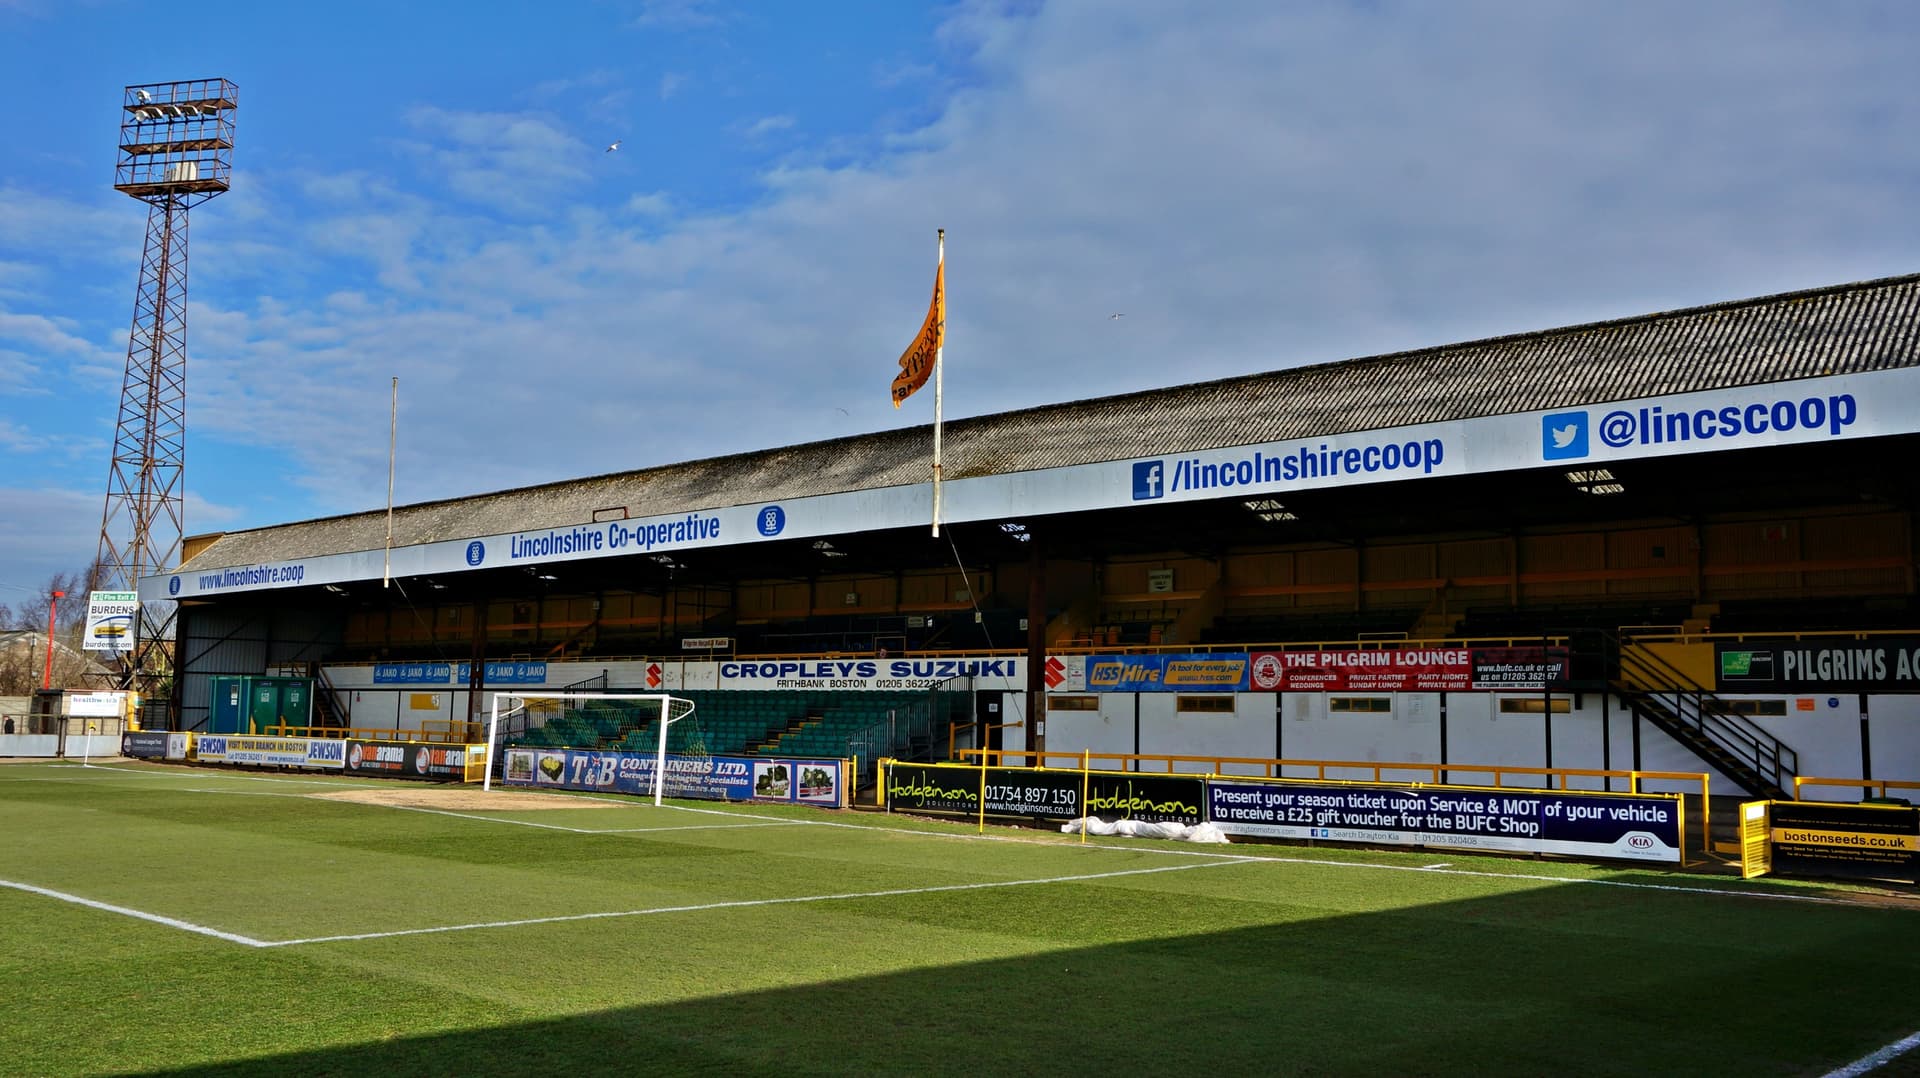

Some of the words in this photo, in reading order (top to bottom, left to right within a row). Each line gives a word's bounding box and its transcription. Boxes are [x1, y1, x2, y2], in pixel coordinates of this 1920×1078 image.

[1599, 394, 1857, 448] @lincscoop
[1171, 438, 1444, 492] /lincolnshirecoop
[511, 526, 603, 559] Lincolnshire
[608, 514, 720, 550] Co-operative
[199, 564, 304, 590] www.lincolnshire.coop
[91, 605, 134, 614] BURDENS
[1285, 654, 1316, 667] THE
[1321, 652, 1390, 666] PILGRIM
[1396, 650, 1469, 665] LOUNGE
[1783, 648, 1887, 681] PILGRIMS
[382, 667, 398, 677] JAKO
[407, 667, 423, 677] JAKO
[433, 667, 449, 677] JAKO
[495, 667, 514, 677] JAKO
[526, 666, 545, 677] JAKO
[721, 662, 877, 679] CROPLEYS
[890, 660, 1015, 678] SUZUKI
[1094, 667, 1119, 681] HSS
[1122, 665, 1160, 682] Hire
[1194, 664, 1205, 672] for
[1205, 664, 1226, 673] every
[1477, 664, 1534, 672] www.bufc.co.uk
[777, 679, 825, 688] FRITHBANK
[829, 680, 867, 688] BOSTON
[876, 679, 902, 688] 01205
[1502, 673, 1526, 681] 01205
[199, 738, 226, 753] JEWSON
[285, 742, 307, 751] BOSTON
[309, 741, 342, 760] JEWSON
[362, 745, 404, 762] vanarama
[571, 756, 618, 786] T&B
[715, 762, 749, 775] LTD.
[704, 776, 749, 785] Specialists
[887, 770, 977, 807] Hodgkinsons
[985, 785, 1022, 800] 01754
[1025, 787, 1047, 802] 897
[1052, 789, 1076, 805] 150
[926, 800, 978, 809] SOLICITORS
[985, 801, 1076, 815] www.hodgkinsons.co.uk
[1214, 789, 1262, 804] Present
[1265, 792, 1294, 807] your
[1298, 793, 1345, 808] season
[1348, 794, 1386, 809] ticket
[1391, 798, 1426, 812] upon
[1430, 797, 1484, 813] Service
[1488, 799, 1500, 814] &
[1503, 799, 1540, 816] MOT
[1545, 800, 1562, 817] of
[1567, 803, 1605, 821] your
[1609, 805, 1668, 823] vehicle
[1134, 813, 1198, 823] SOLICITORS
[1215, 805, 1228, 819] to
[1231, 808, 1274, 821] receive
[1277, 810, 1285, 821] a
[1287, 808, 1313, 823] £25
[1317, 809, 1341, 826] gift
[1344, 811, 1398, 826] voucher
[1401, 813, 1422, 828] for
[1426, 813, 1451, 829] the
[1455, 815, 1496, 831] BUFC
[1500, 818, 1539, 837] Shop
[1358, 832, 1386, 841] Drayton
[1388, 833, 1399, 841] Kia
[1422, 835, 1446, 843] 01205
[1632, 838, 1649, 846] KIA
[1784, 831, 1905, 848] bostonseeds.co.uk
